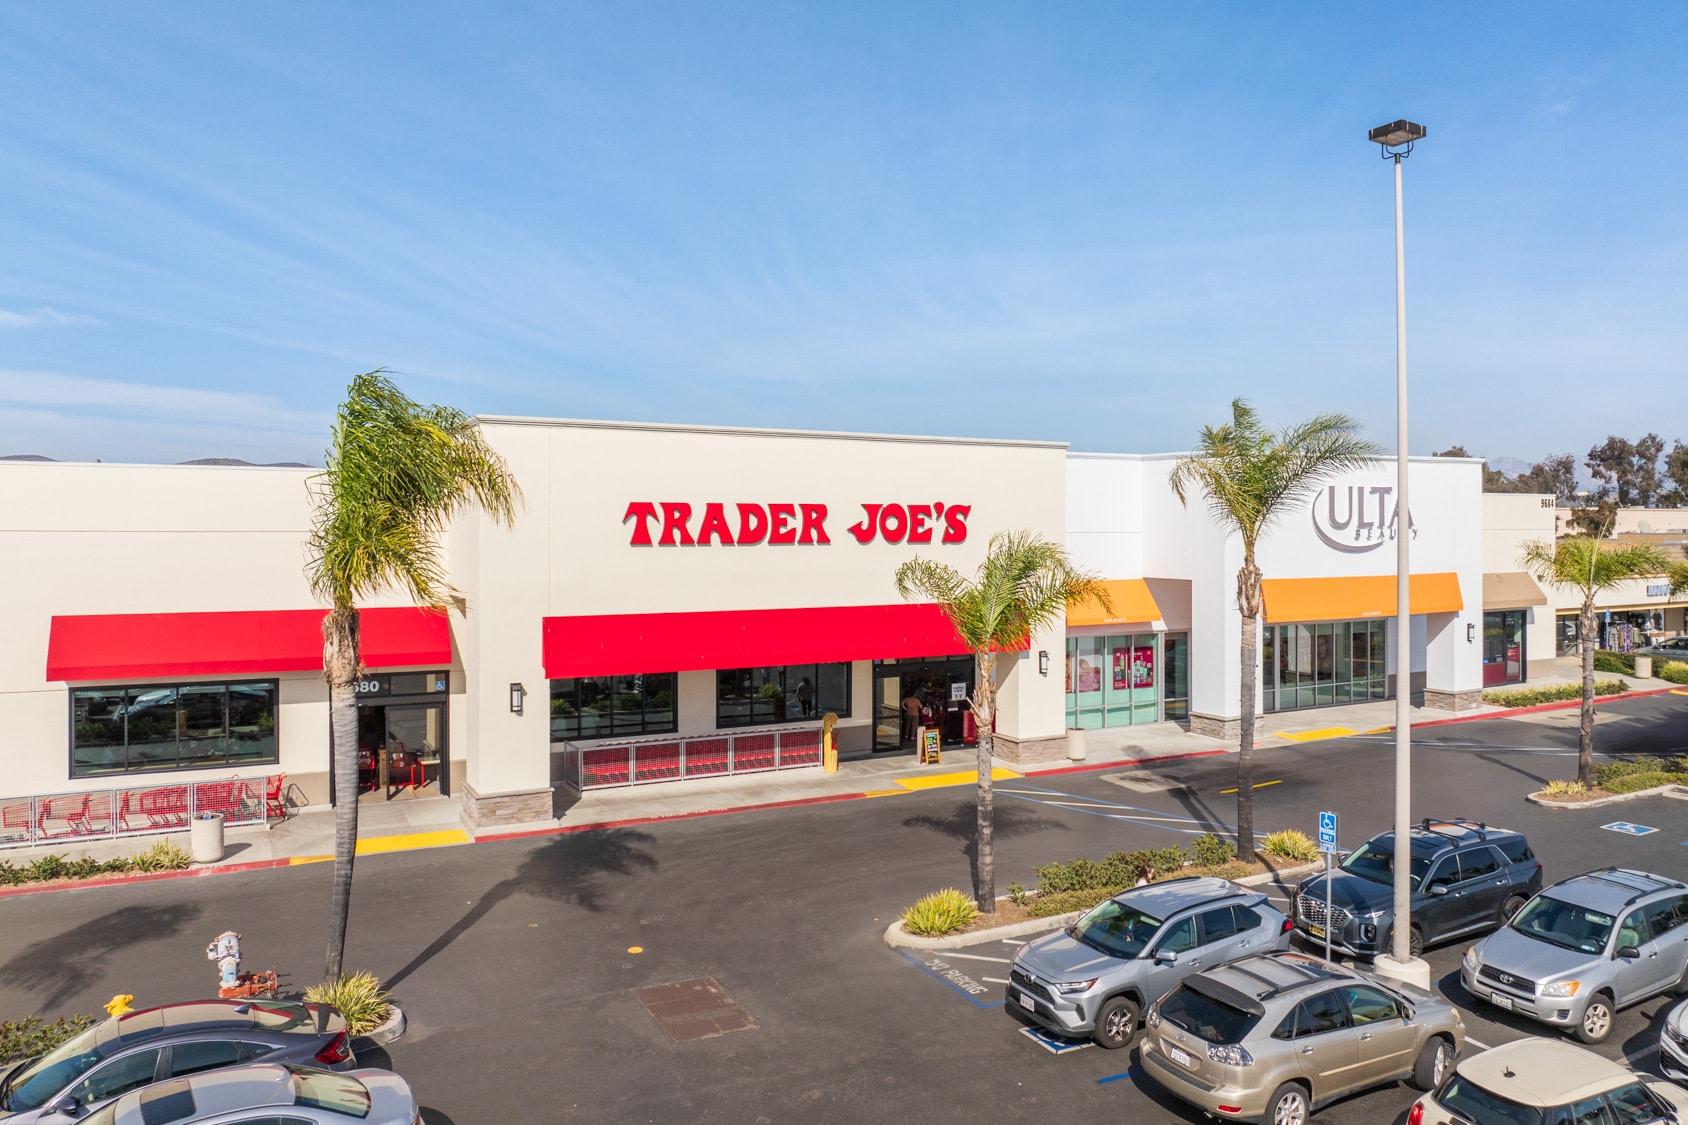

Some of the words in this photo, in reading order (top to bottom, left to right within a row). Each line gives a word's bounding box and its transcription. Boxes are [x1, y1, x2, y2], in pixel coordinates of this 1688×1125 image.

[622, 501, 831, 547] TRADER
[847, 501, 972, 546] JOE'S
[1354, 529, 1418, 541] BEAUY
